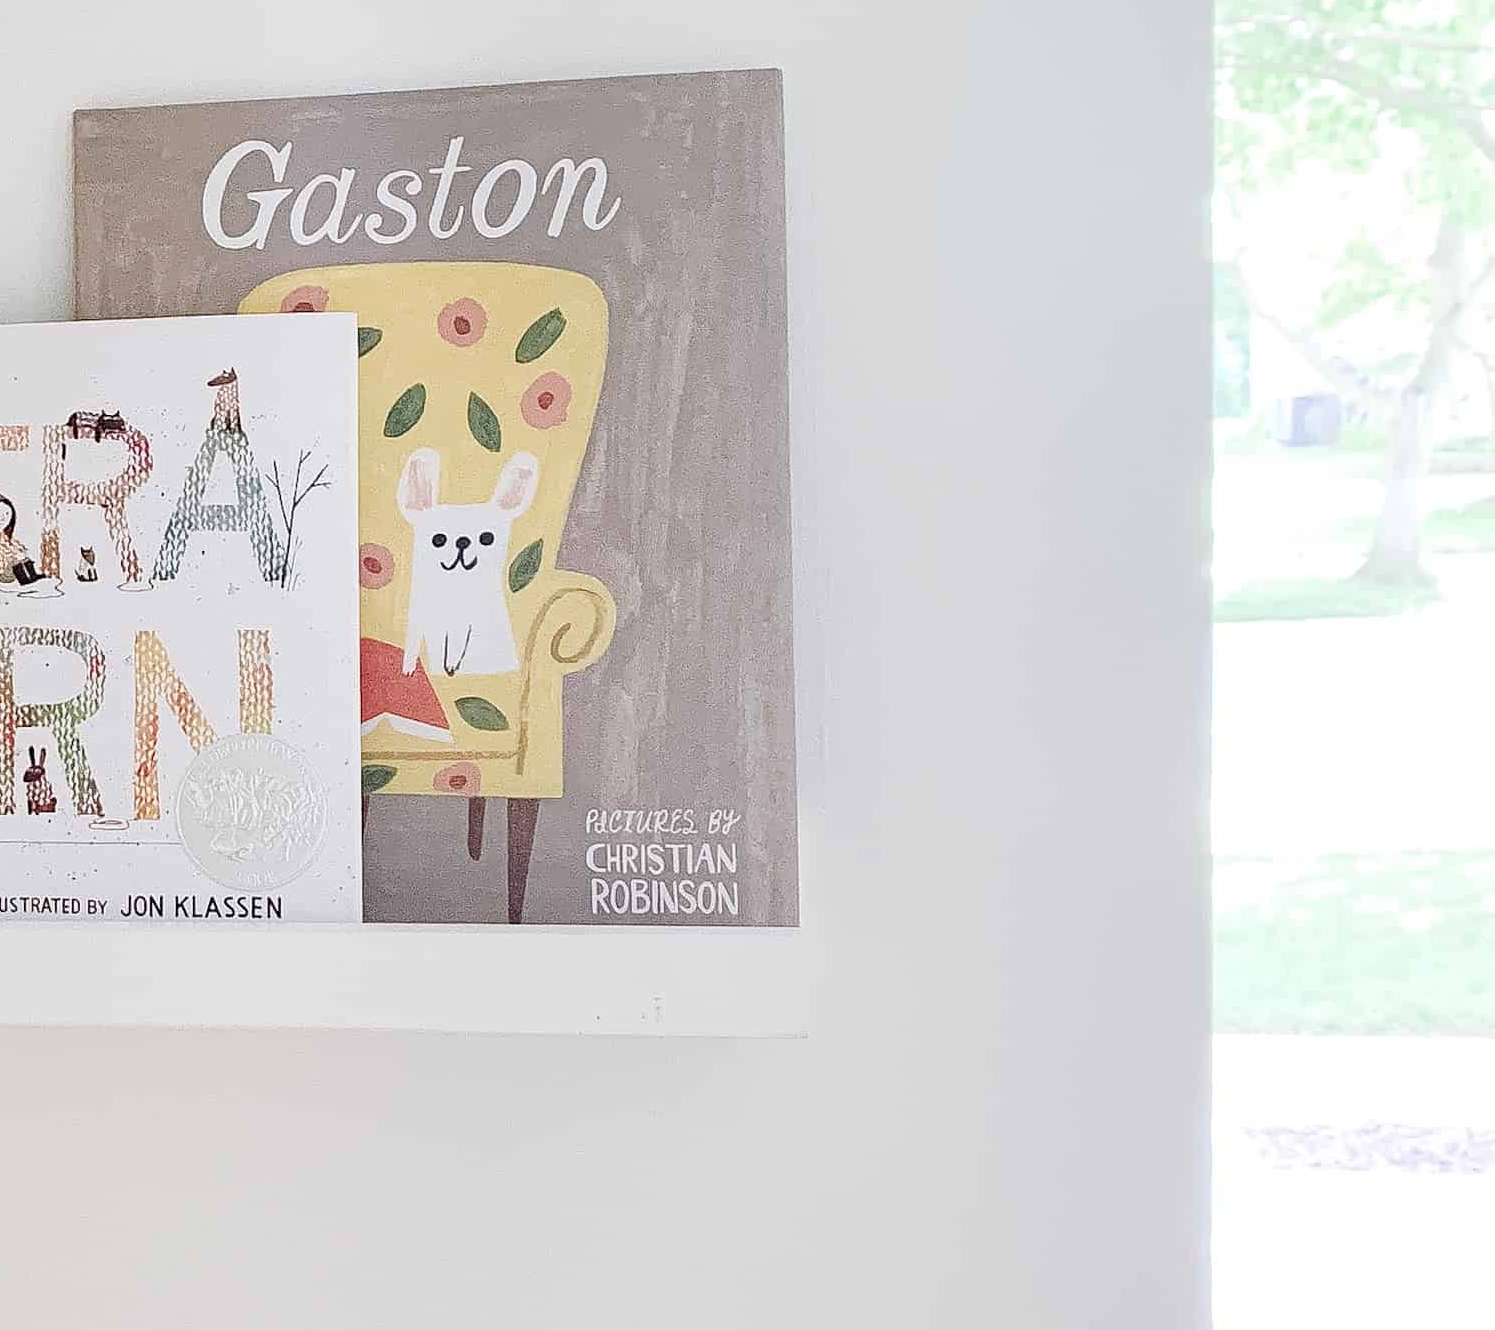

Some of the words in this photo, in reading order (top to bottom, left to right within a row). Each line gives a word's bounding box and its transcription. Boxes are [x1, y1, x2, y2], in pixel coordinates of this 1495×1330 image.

[202, 136, 621, 251] Gaston
[586, 843, 738, 875] CHRISTIAN
[87, 898, 107, 915] BY
[121, 895, 164, 917] JON
[175, 896, 283, 919] KLASSEN
[591, 878, 739, 915] ROBINSON
